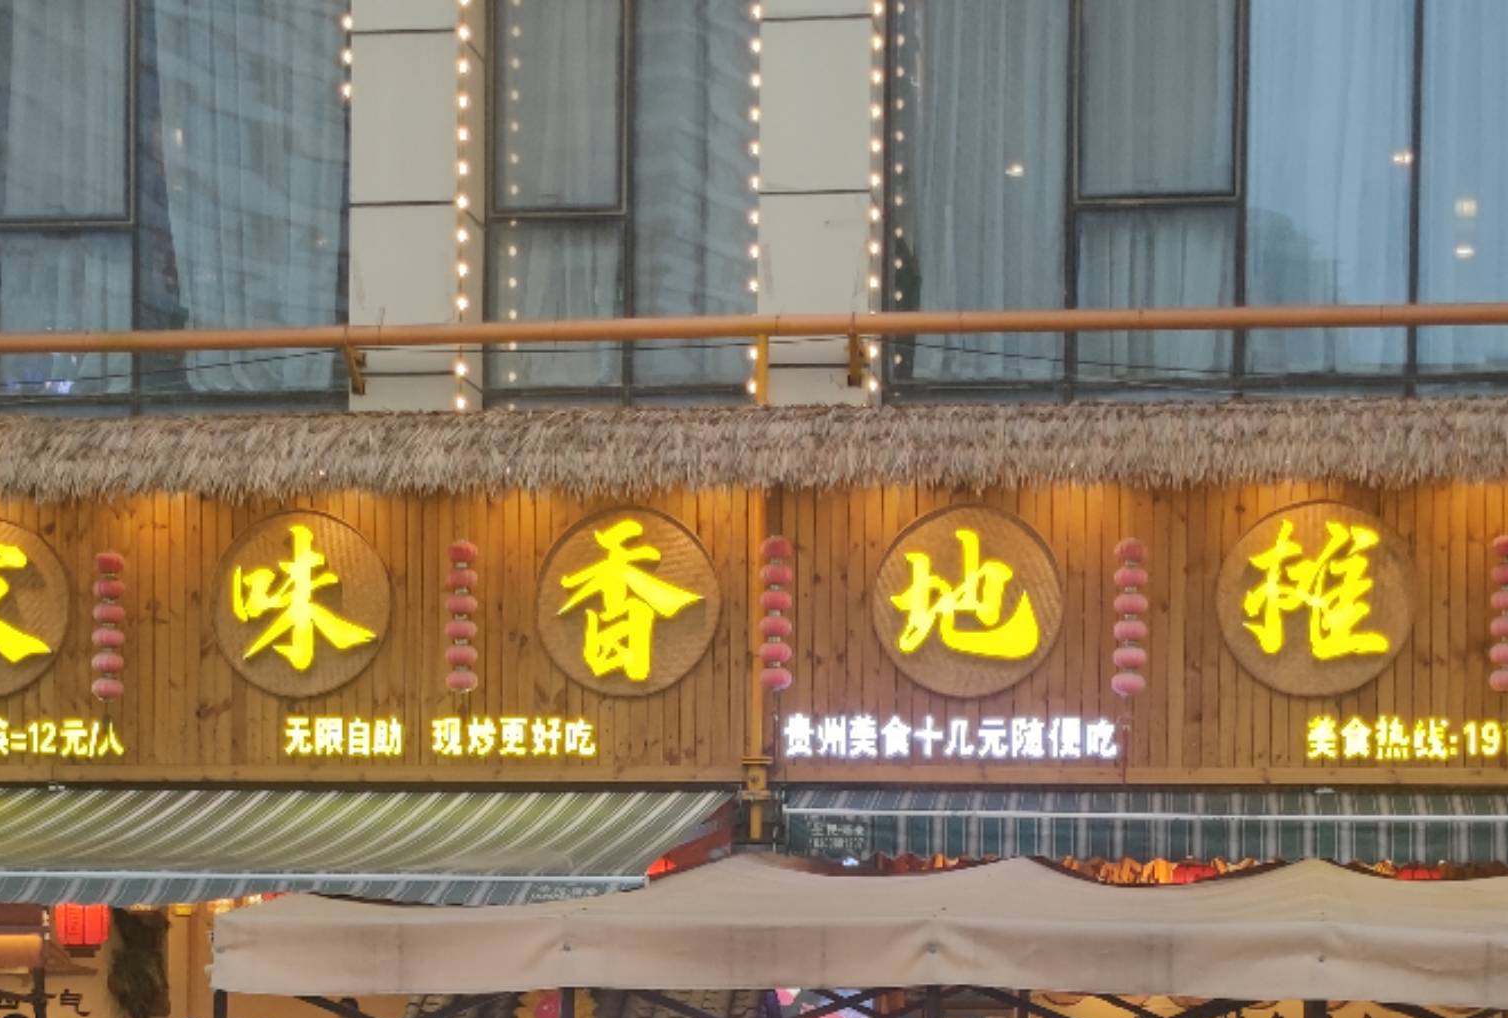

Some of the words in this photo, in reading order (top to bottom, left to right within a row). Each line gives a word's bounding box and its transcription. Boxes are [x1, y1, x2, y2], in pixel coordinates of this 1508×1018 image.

[284, 716, 403, 757] 无限自助
[431, 716, 597, 757] 现炒更好吃
[783, 712, 1118, 759] 贵州美食十几元随便吃
